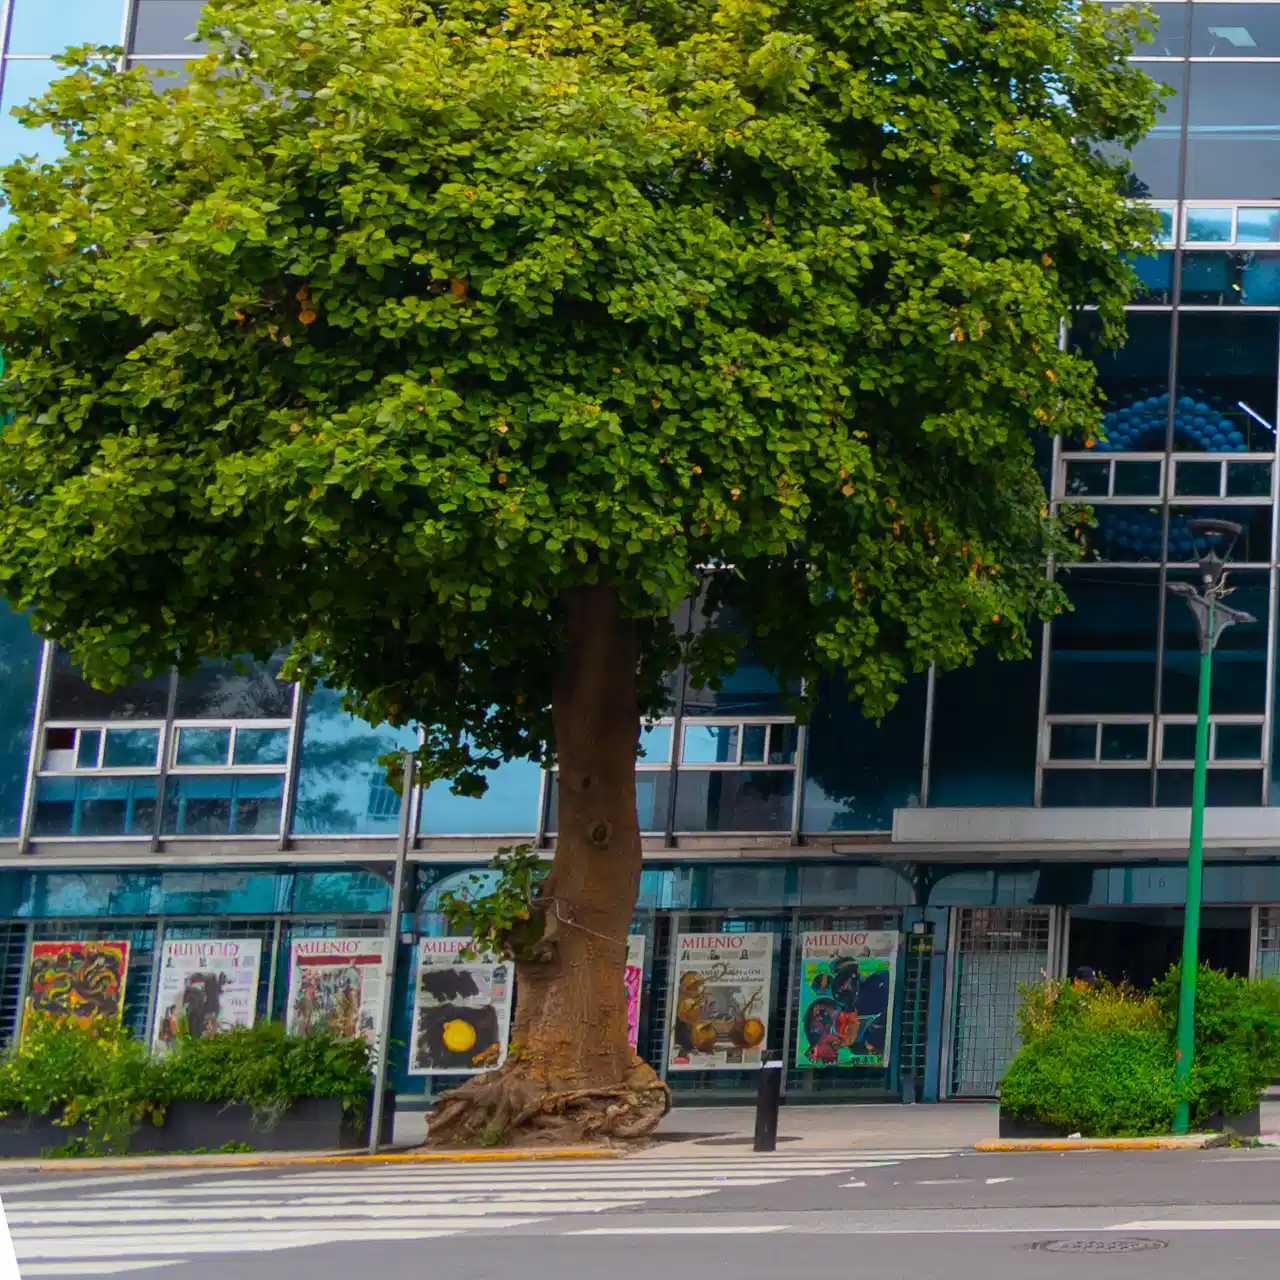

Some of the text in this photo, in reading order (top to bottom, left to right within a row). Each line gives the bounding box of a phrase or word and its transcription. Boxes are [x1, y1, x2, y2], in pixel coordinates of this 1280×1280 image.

[681, 936, 745, 949] MILENIO
[805, 933, 869, 946] MILENIO
[294, 940, 362, 954] MILENIO
